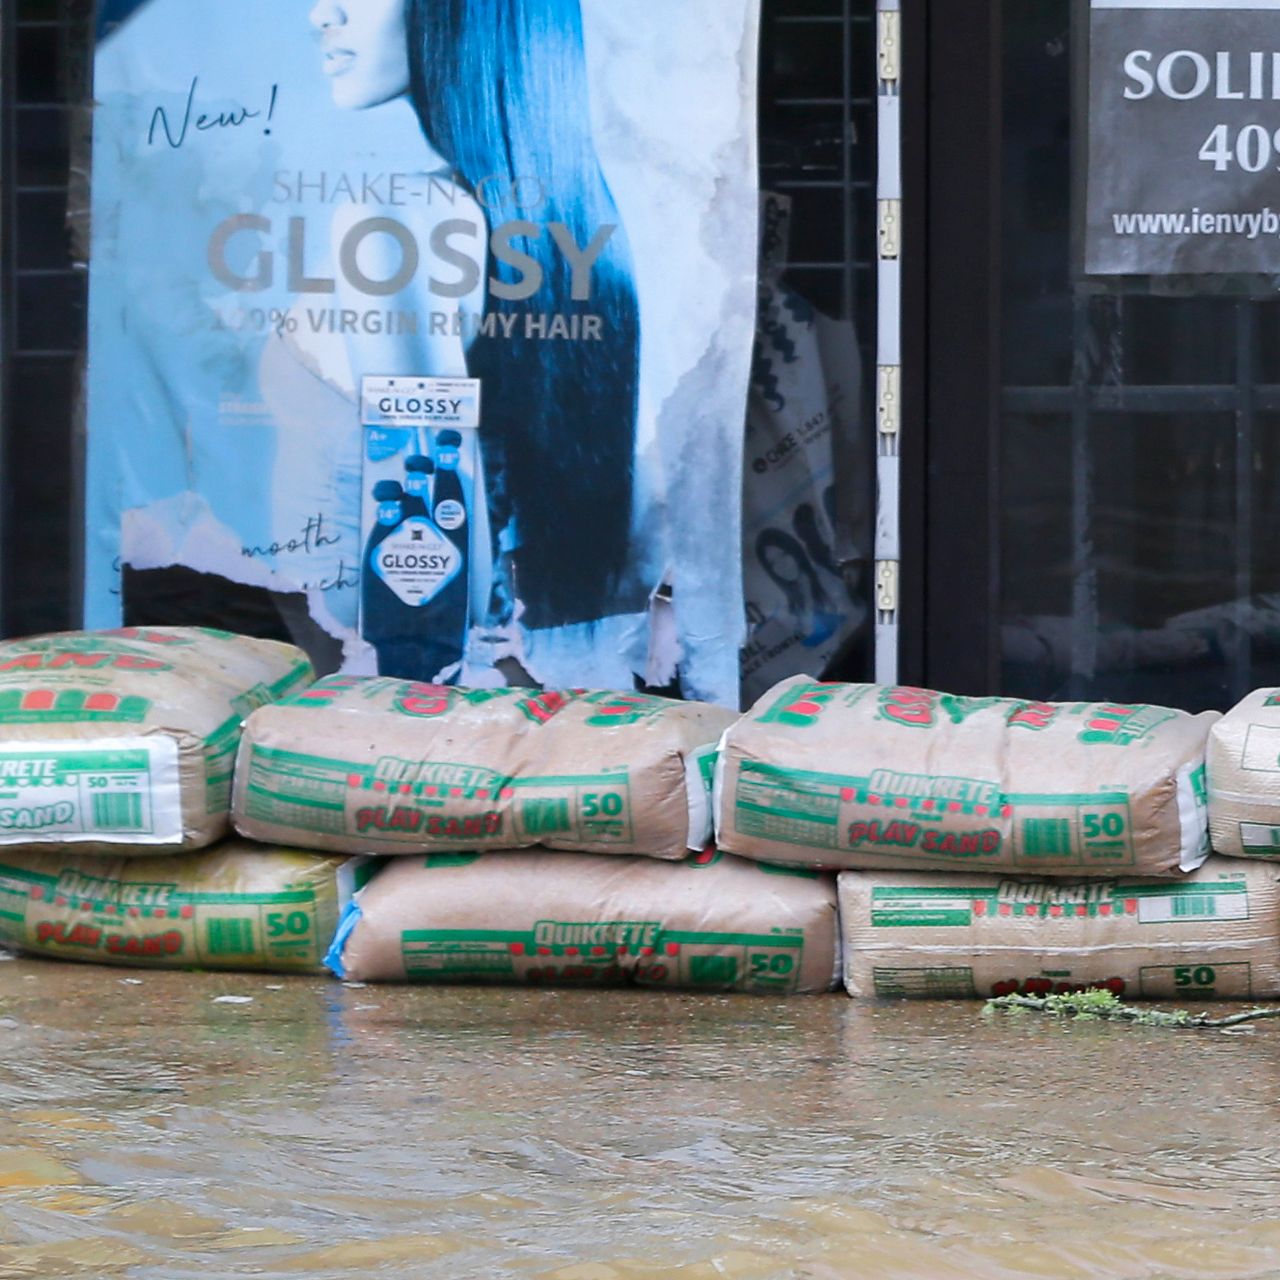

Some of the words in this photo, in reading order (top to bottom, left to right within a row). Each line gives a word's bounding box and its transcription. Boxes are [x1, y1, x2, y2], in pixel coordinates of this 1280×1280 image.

[147, 76, 280, 148] New!
[271, 169, 545, 210] SHAKE-N-GO
[206, 213, 618, 302] GLOSSY
[305, 308, 418, 336] VIRGIN
[429, 310, 513, 338] REMY
[524, 313, 602, 341] HAIR
[378, 397, 462, 414] GLOSSY
[382, 554, 451, 569] GLOSSY
[375, 756, 499, 791] QUIKRETE
[868, 769, 998, 805] QUIKRETE
[581, 792, 623, 817] 50
[1082, 812, 1124, 839] 50
[266, 911, 310, 939] 50
[749, 953, 794, 975] 50
[1173, 965, 1215, 987] 50
